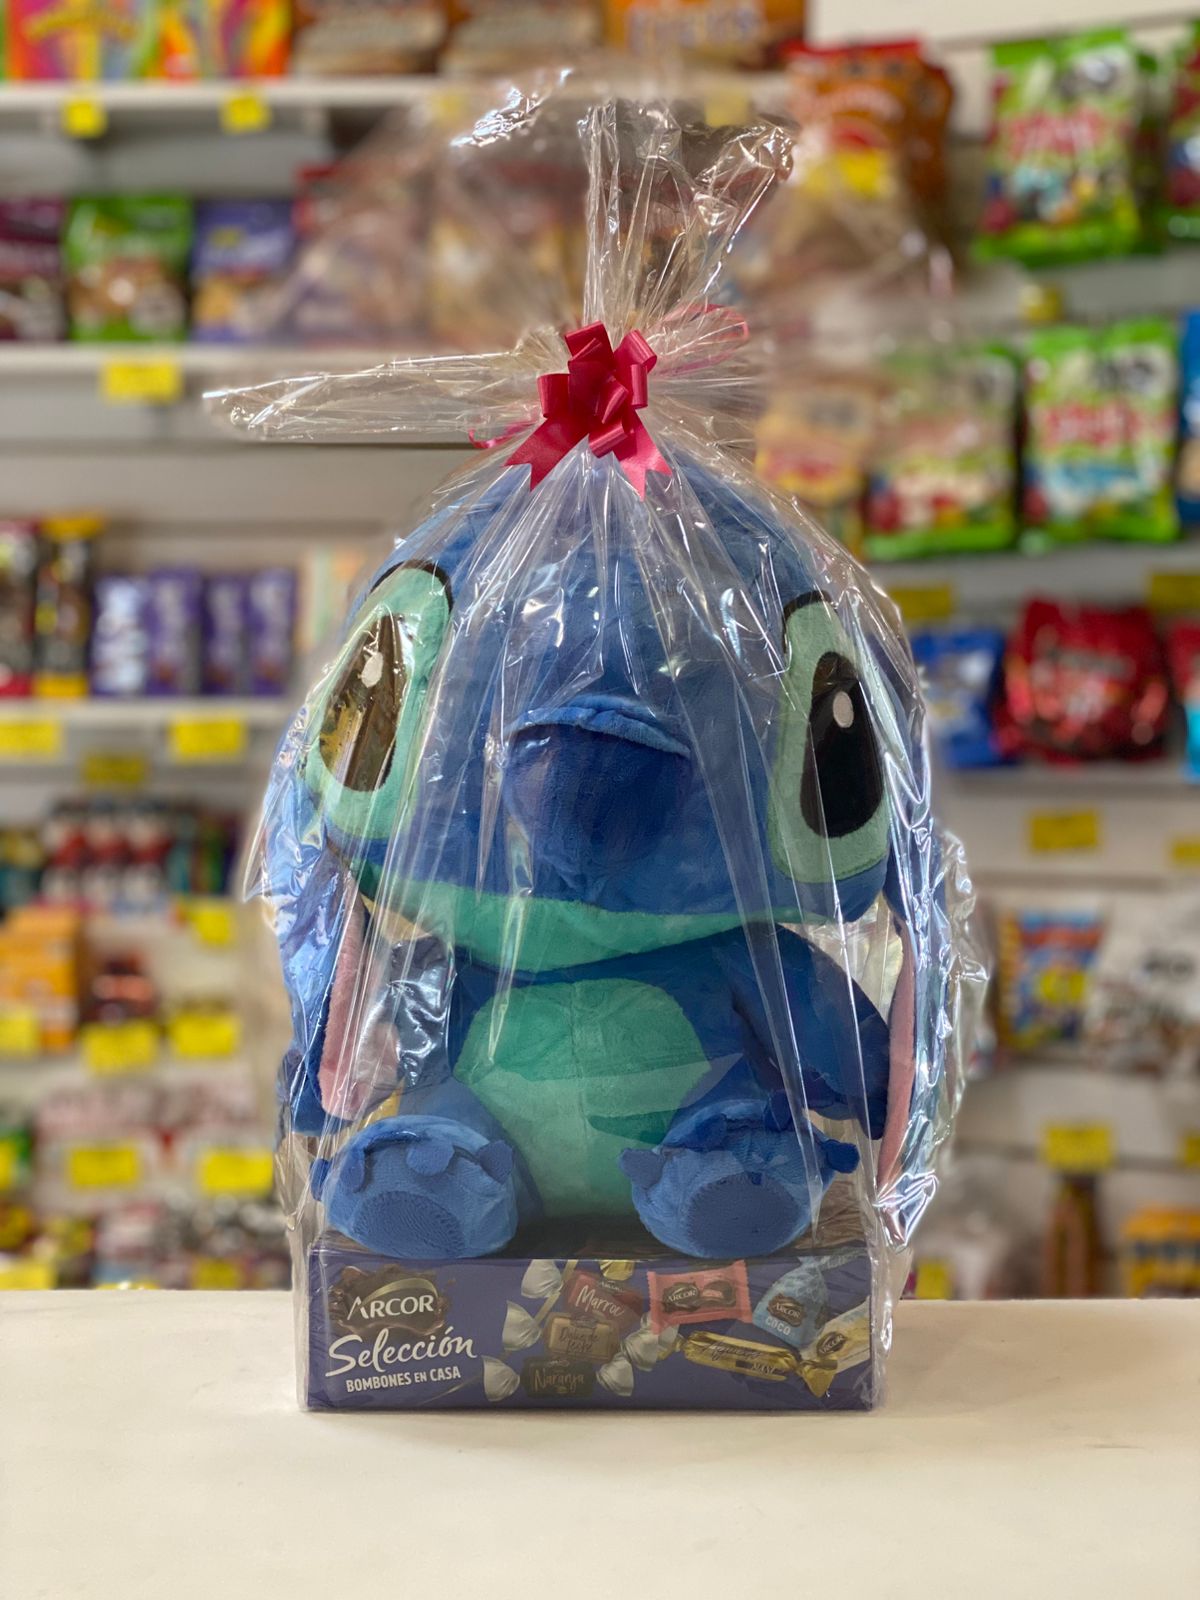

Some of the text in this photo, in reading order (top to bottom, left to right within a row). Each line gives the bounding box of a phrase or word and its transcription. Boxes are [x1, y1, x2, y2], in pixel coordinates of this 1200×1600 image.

[347, 1294, 434, 1321] ARCOR
[575, 1284, 624, 1316] Marroc
[668, 1289, 697, 1302] ARCOR
[774, 1302, 801, 1319] ARCOR
[765, 1316, 791, 1336] COCO
[325, 1326, 478, 1377] Selección
[346, 1366, 461, 1393] BOMBONES EN CASA
[534, 1367, 585, 1392] Naranja
